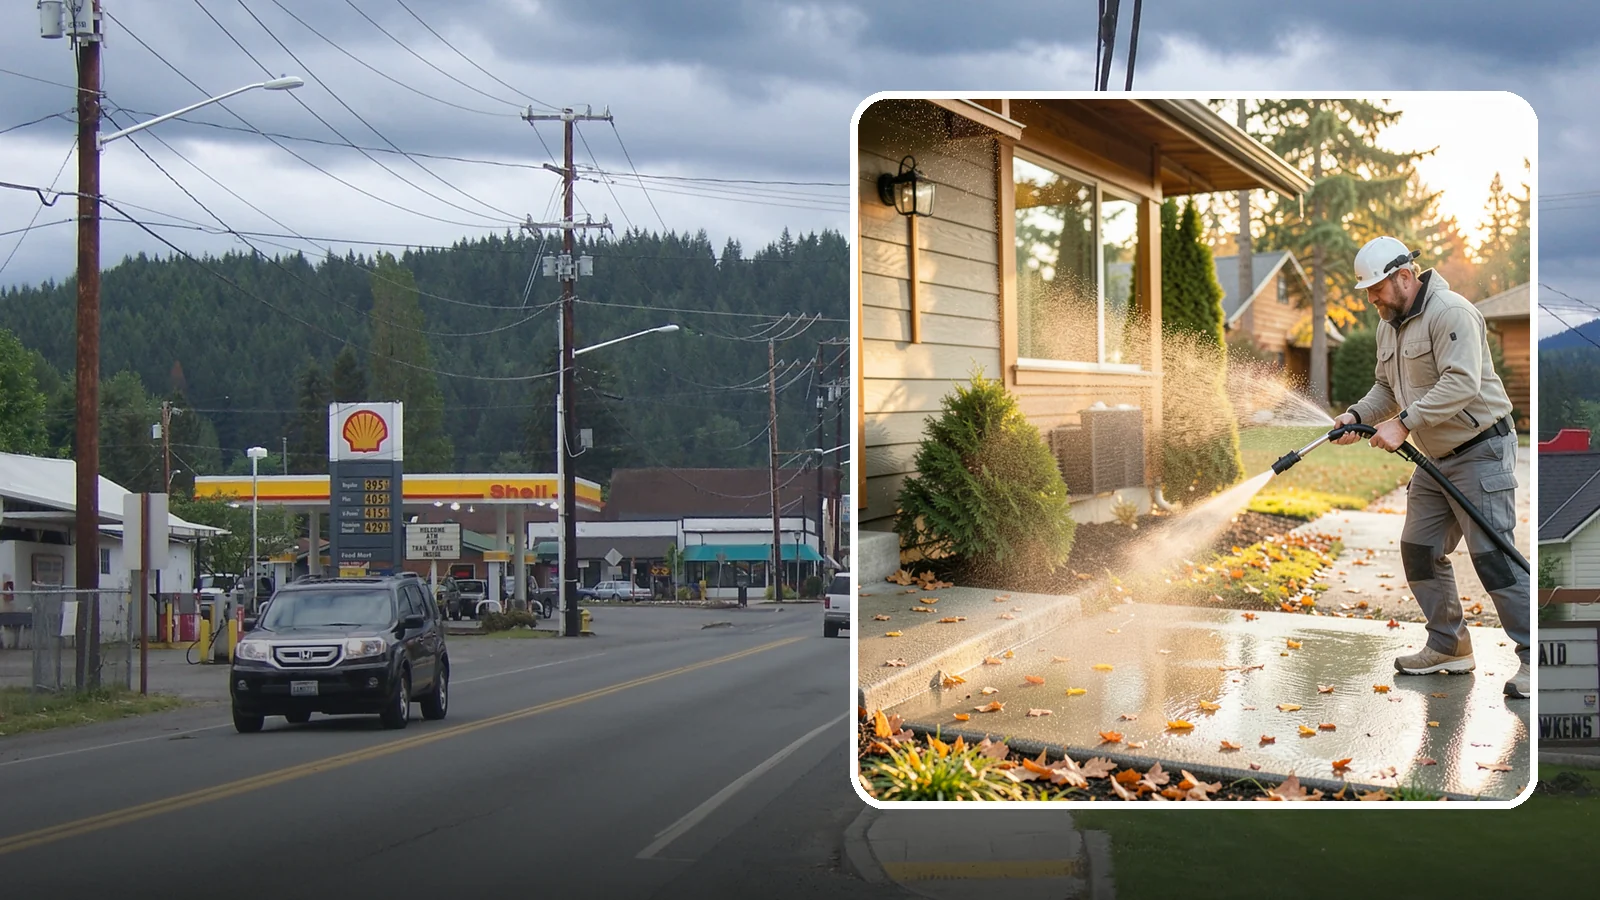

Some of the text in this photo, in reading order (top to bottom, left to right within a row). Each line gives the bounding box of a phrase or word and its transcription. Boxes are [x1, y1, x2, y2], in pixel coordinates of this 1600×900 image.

[366, 480, 384, 490] 395
[490, 484, 547, 499] Shell
[366, 494, 384, 504] 405
[366, 508, 384, 518] 415
[366, 522, 384, 533] 429
